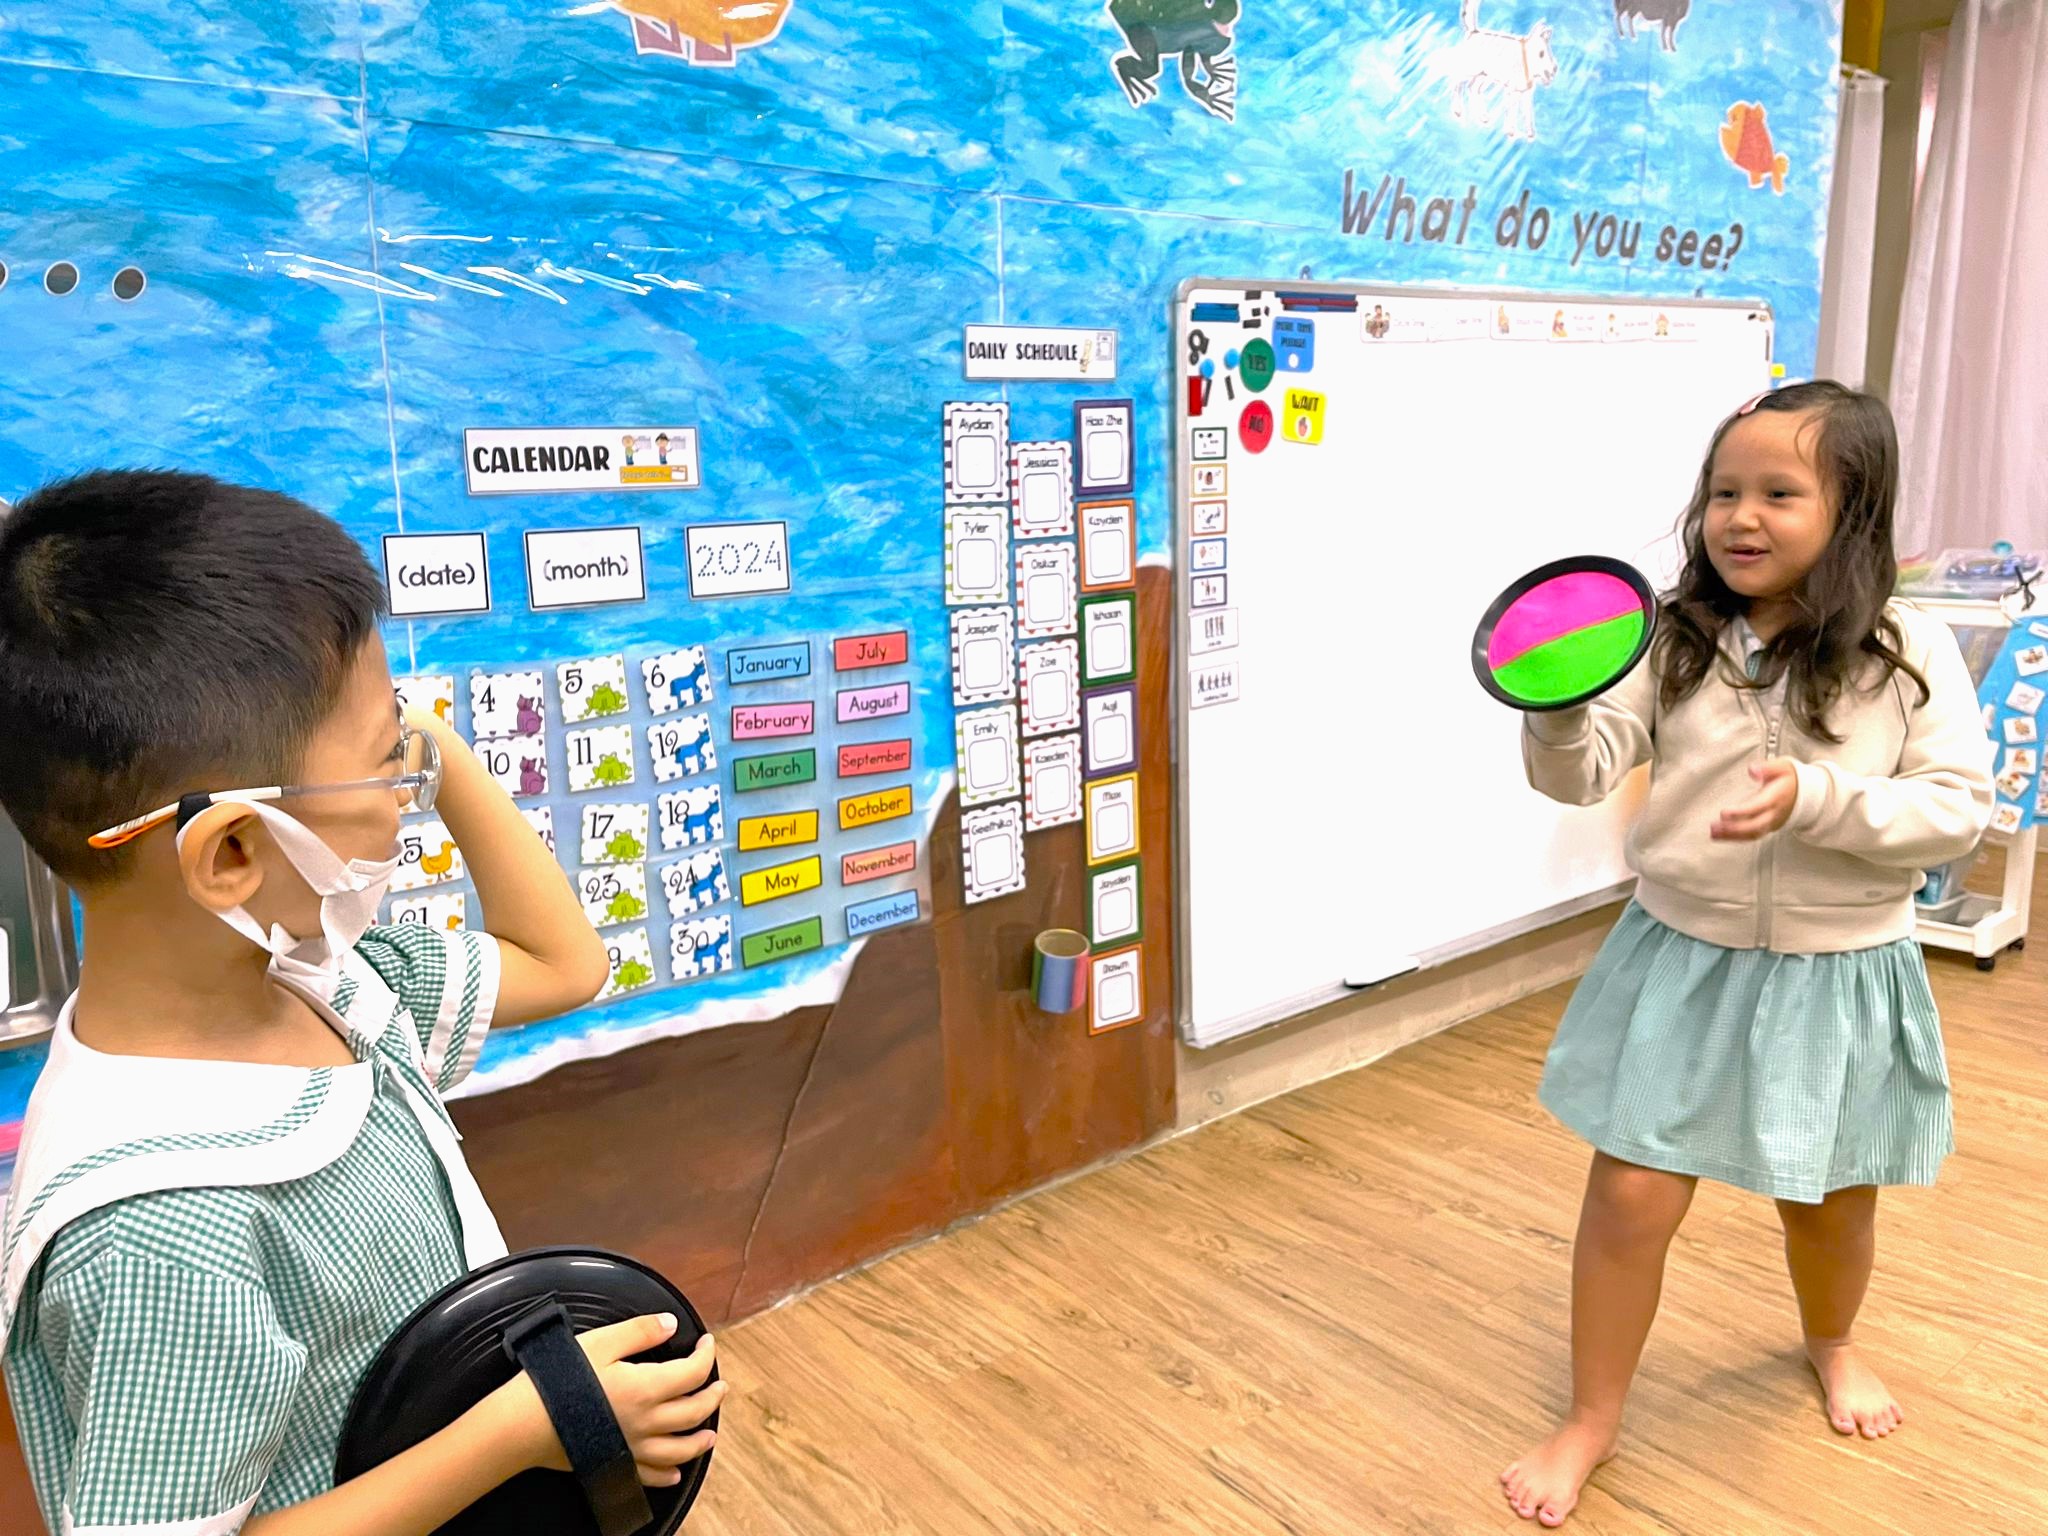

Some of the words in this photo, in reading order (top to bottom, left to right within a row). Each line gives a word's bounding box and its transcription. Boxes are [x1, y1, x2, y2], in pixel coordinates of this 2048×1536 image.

[1342, 167, 1477, 244] What
[1495, 189, 1550, 250] do
[1570, 209, 1642, 266] you
[1655, 222, 1743, 272] see?
[968, 341, 1008, 360] DAILY
[1015, 342, 1078, 361] SCHEDULE
[1291, 393, 1320, 411] WAIT
[1106, 414, 1123, 425] Zhe
[472, 445, 610, 474] CALENDAR
[1023, 457, 1059, 468] Jessica
[963, 521, 989, 535] Tyler
[543, 554, 629, 581] (month)
[695, 540, 783, 579] 2024
[398, 562, 476, 588] (date)
[963, 622, 1000, 636] Jasper
[735, 653, 802, 675] January
[856, 642, 888, 661] July
[1039, 655, 1057, 668] Zoe
[565, 668, 583, 694] 5
[650, 664, 666, 689] 6
[479, 684, 496, 714] 4
[849, 691, 899, 715] August
[736, 711, 810, 732] February
[972, 722, 1000, 737] Emily
[574, 737, 594, 765] 11
[655, 730, 679, 759] 12
[484, 748, 510, 776] 10
[748, 755, 802, 780] March
[841, 748, 908, 770] September
[667, 800, 690, 826] 18
[845, 795, 904, 820] October
[589, 811, 615, 840] 17
[759, 819, 797, 844] April
[397, 836, 423, 867] 5
[845, 849, 913, 876] November
[585, 873, 622, 903] 23
[669, 864, 699, 896] 24
[765, 871, 800, 892] May
[1098, 874, 1131, 890] Jayden
[849, 902, 918, 929] December
[676, 929, 710, 955] 30
[763, 932, 803, 954] June
